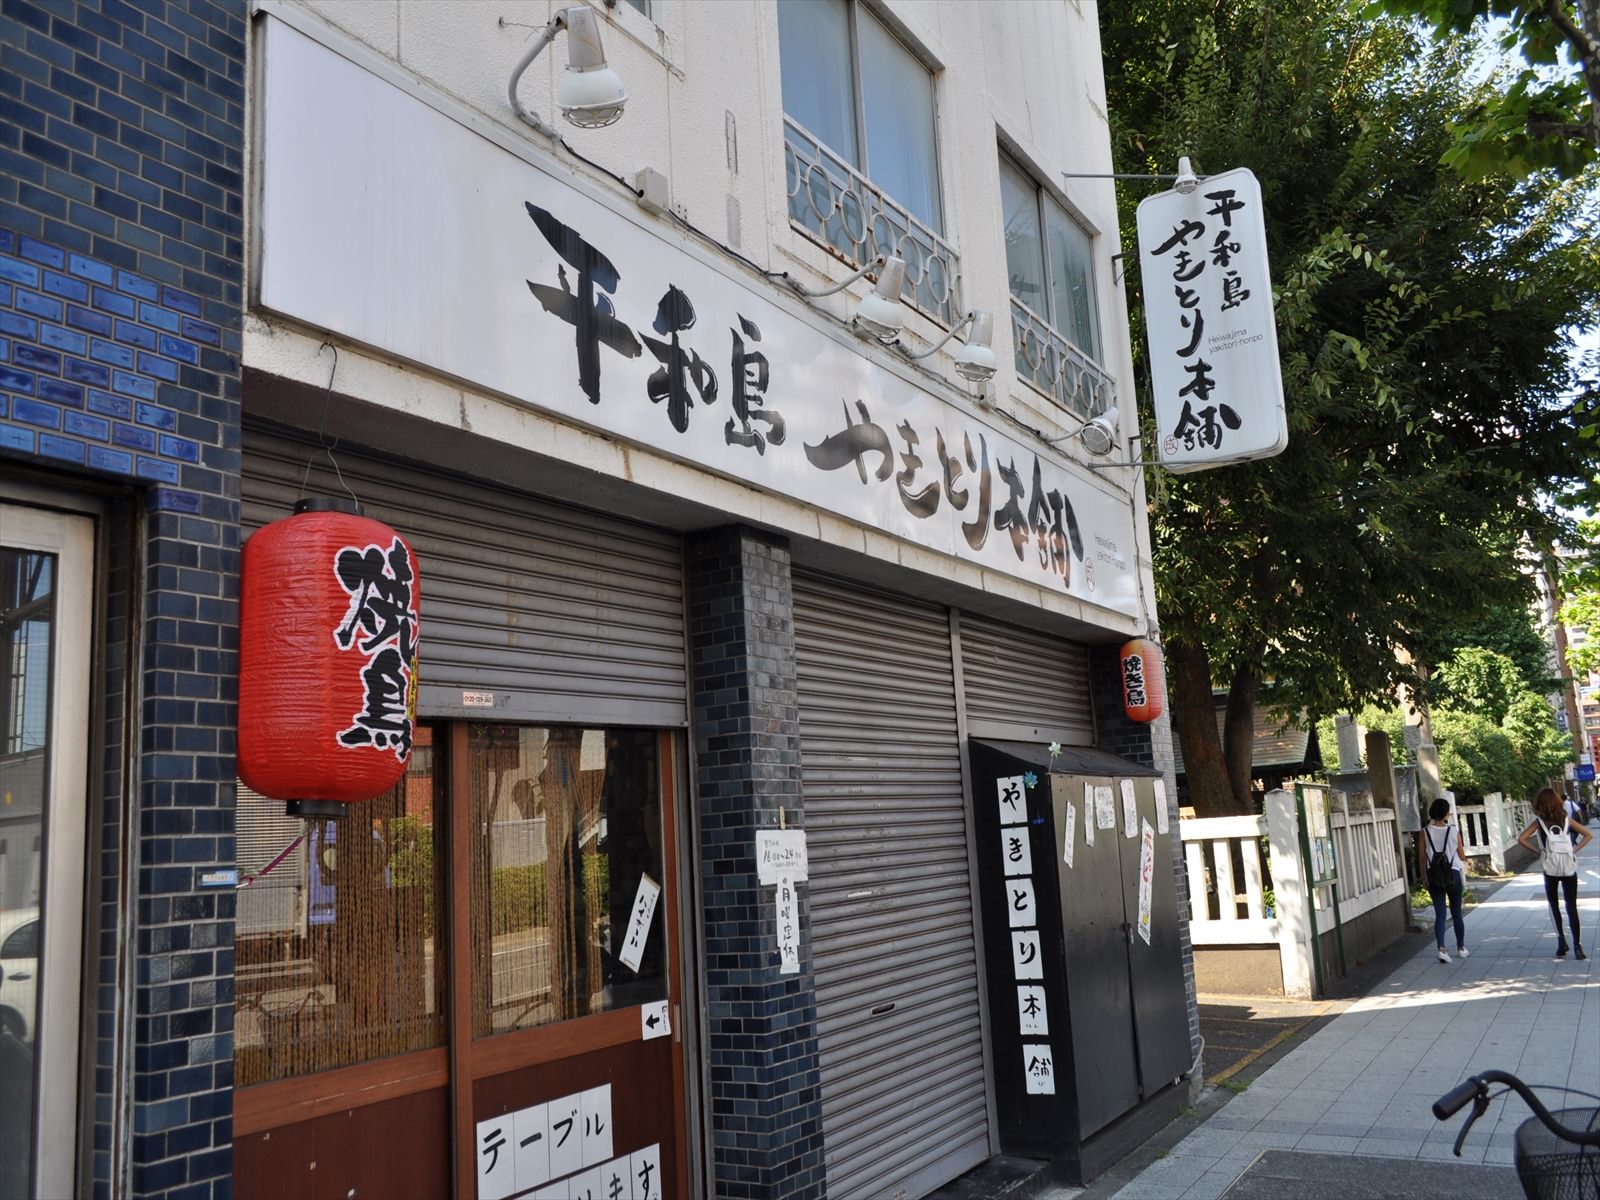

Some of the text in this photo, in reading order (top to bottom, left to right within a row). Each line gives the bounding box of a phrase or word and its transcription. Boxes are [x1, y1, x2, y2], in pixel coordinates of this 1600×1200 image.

[1204, 189, 1251, 312] 平和島
[525, 201, 1085, 590] 平和島 やきとり本舗
[1151, 219, 1242, 451] やきとり本舗
[1208, 328, 1248, 345] Heiwajima
[1209, 334, 1264, 355] yakitori-honpo
[335, 536, 418, 762] 焼鳥
[1122, 655, 1147, 707] 焼き鳥
[1002, 781, 1052, 1077] やきとり本舗
[482, 1109, 605, 1174] テーブル
